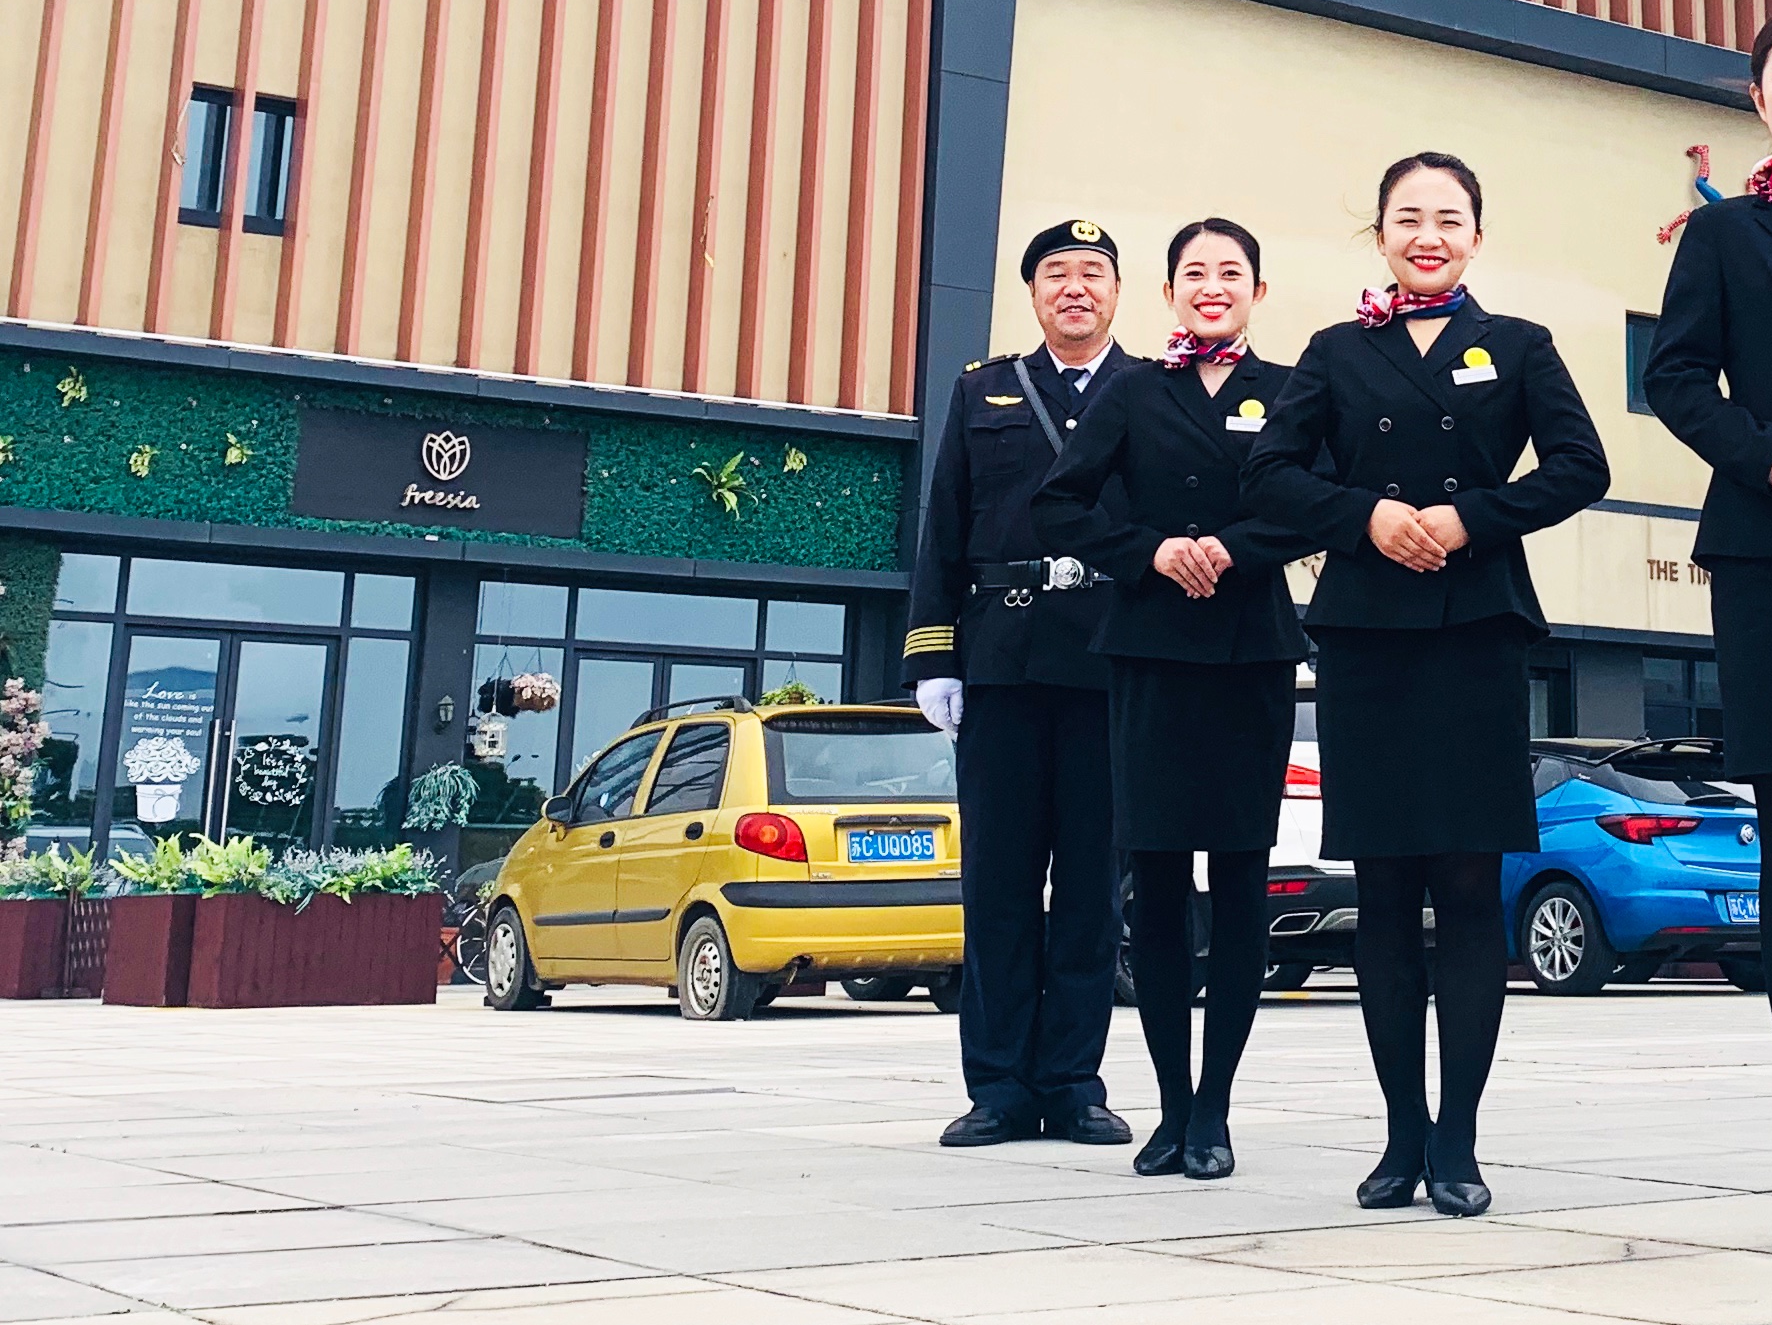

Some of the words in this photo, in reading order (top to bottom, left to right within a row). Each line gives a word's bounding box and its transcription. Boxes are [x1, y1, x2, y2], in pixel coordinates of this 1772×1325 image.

[400, 483, 481, 509] freesia
[1647, 559, 1678, 582] THE
[142, 680, 185, 700] Love
[141, 701, 155, 709] the
[157, 702, 171, 710] sun
[172, 703, 200, 714] coming
[133, 712, 144, 721] of
[145, 713, 160, 721] the
[161, 714, 187, 723] clouds
[187, 716, 203, 724] and
